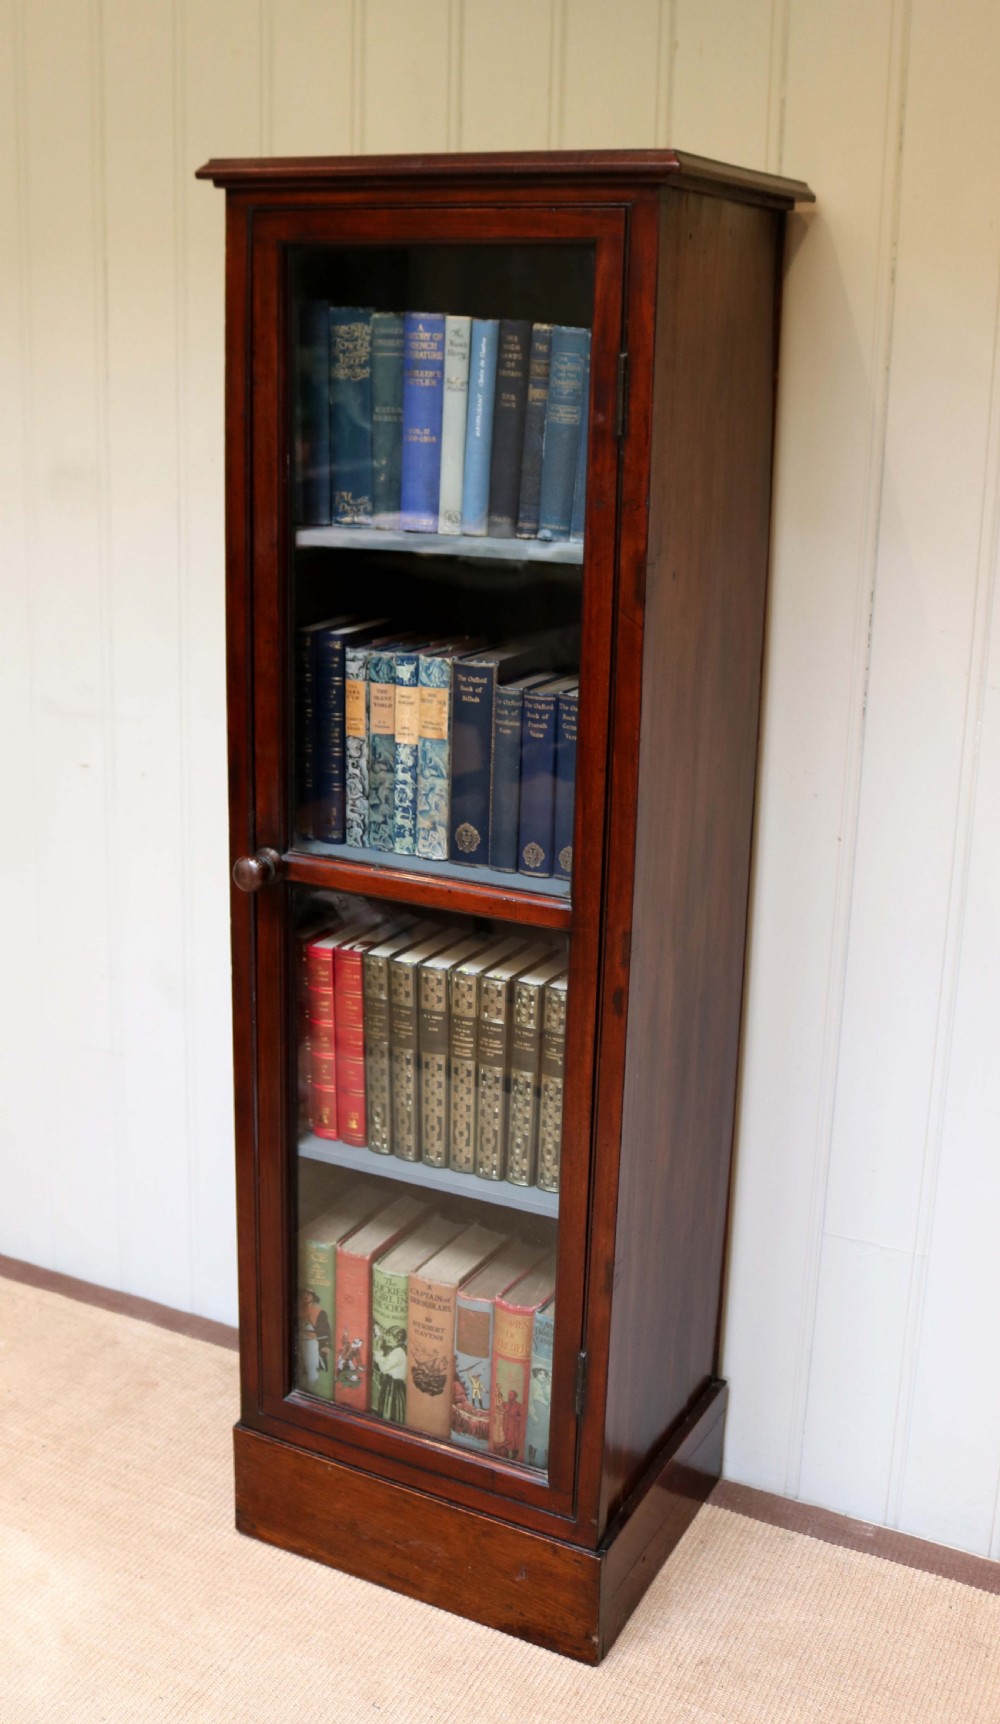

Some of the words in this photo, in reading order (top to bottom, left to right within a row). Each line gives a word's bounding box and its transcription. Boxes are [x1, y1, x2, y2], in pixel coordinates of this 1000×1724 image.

[418, 323, 425, 332] A
[468, 676, 488, 684] Oxford
[460, 684, 473, 692] Book
[533, 702, 554, 710] Oxford
[529, 730, 544, 738] Verse
[410, 1287, 441, 1302] CAPTAIN
